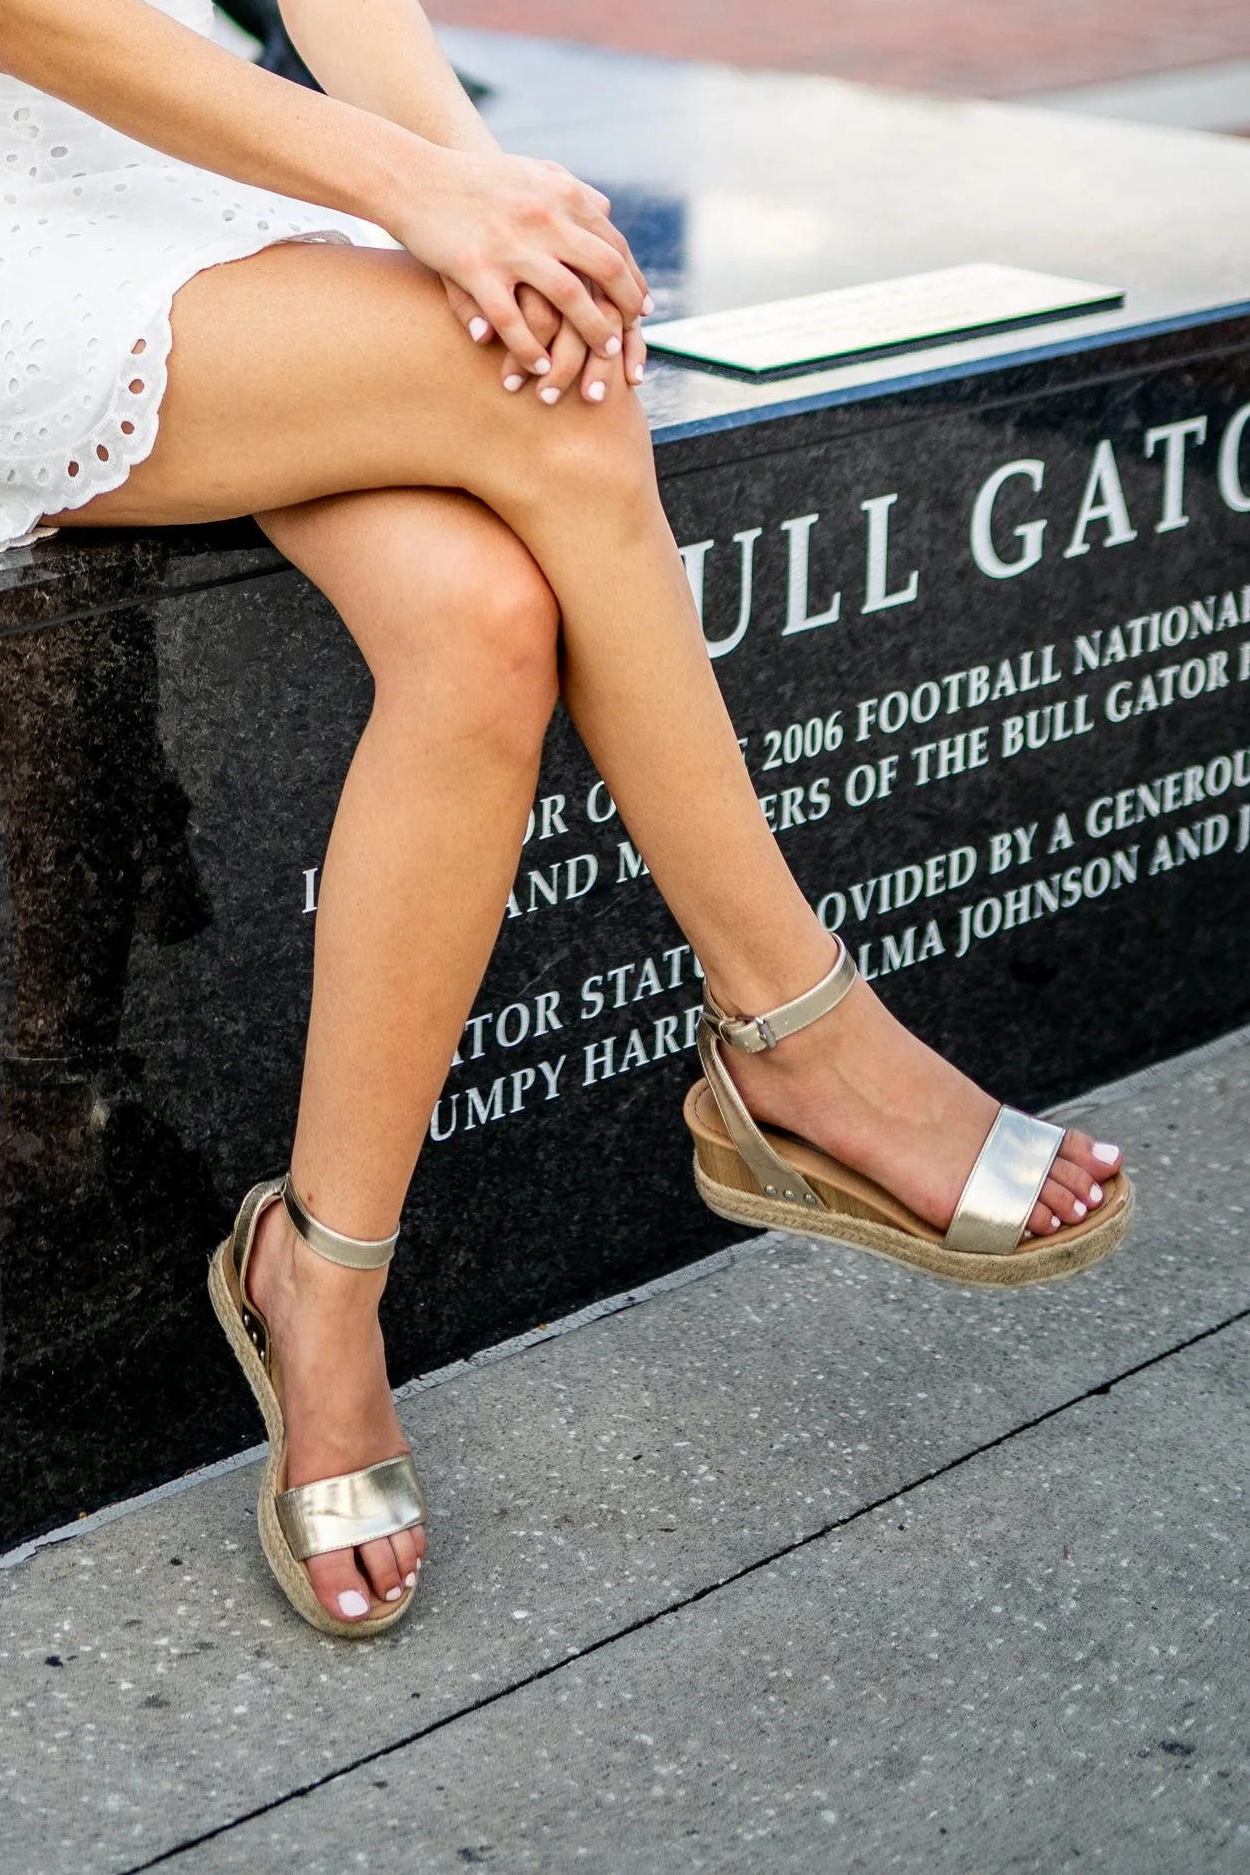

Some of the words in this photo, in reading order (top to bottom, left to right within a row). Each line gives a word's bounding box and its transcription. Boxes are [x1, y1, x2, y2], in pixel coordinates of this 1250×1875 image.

[679, 493, 919, 661] ULL
[762, 710, 844, 771] 2006
[855, 644, 1061, 742] FOOTBALL
[845, 755, 899, 807] OF
[911, 726, 990, 786] THE
[1002, 694, 1095, 759] BULL
[1105, 650, 1230, 723] GATOR
[816, 845, 978, 932] OVIDED
[989, 822, 1039, 874] BY
[1047, 812, 1075, 854] A
[430, 1054, 567, 1141] UMPY
[858, 920, 946, 982] LMA
[956, 845, 1141, 957] JOHNSON
[1148, 814, 1229, 876] AND
